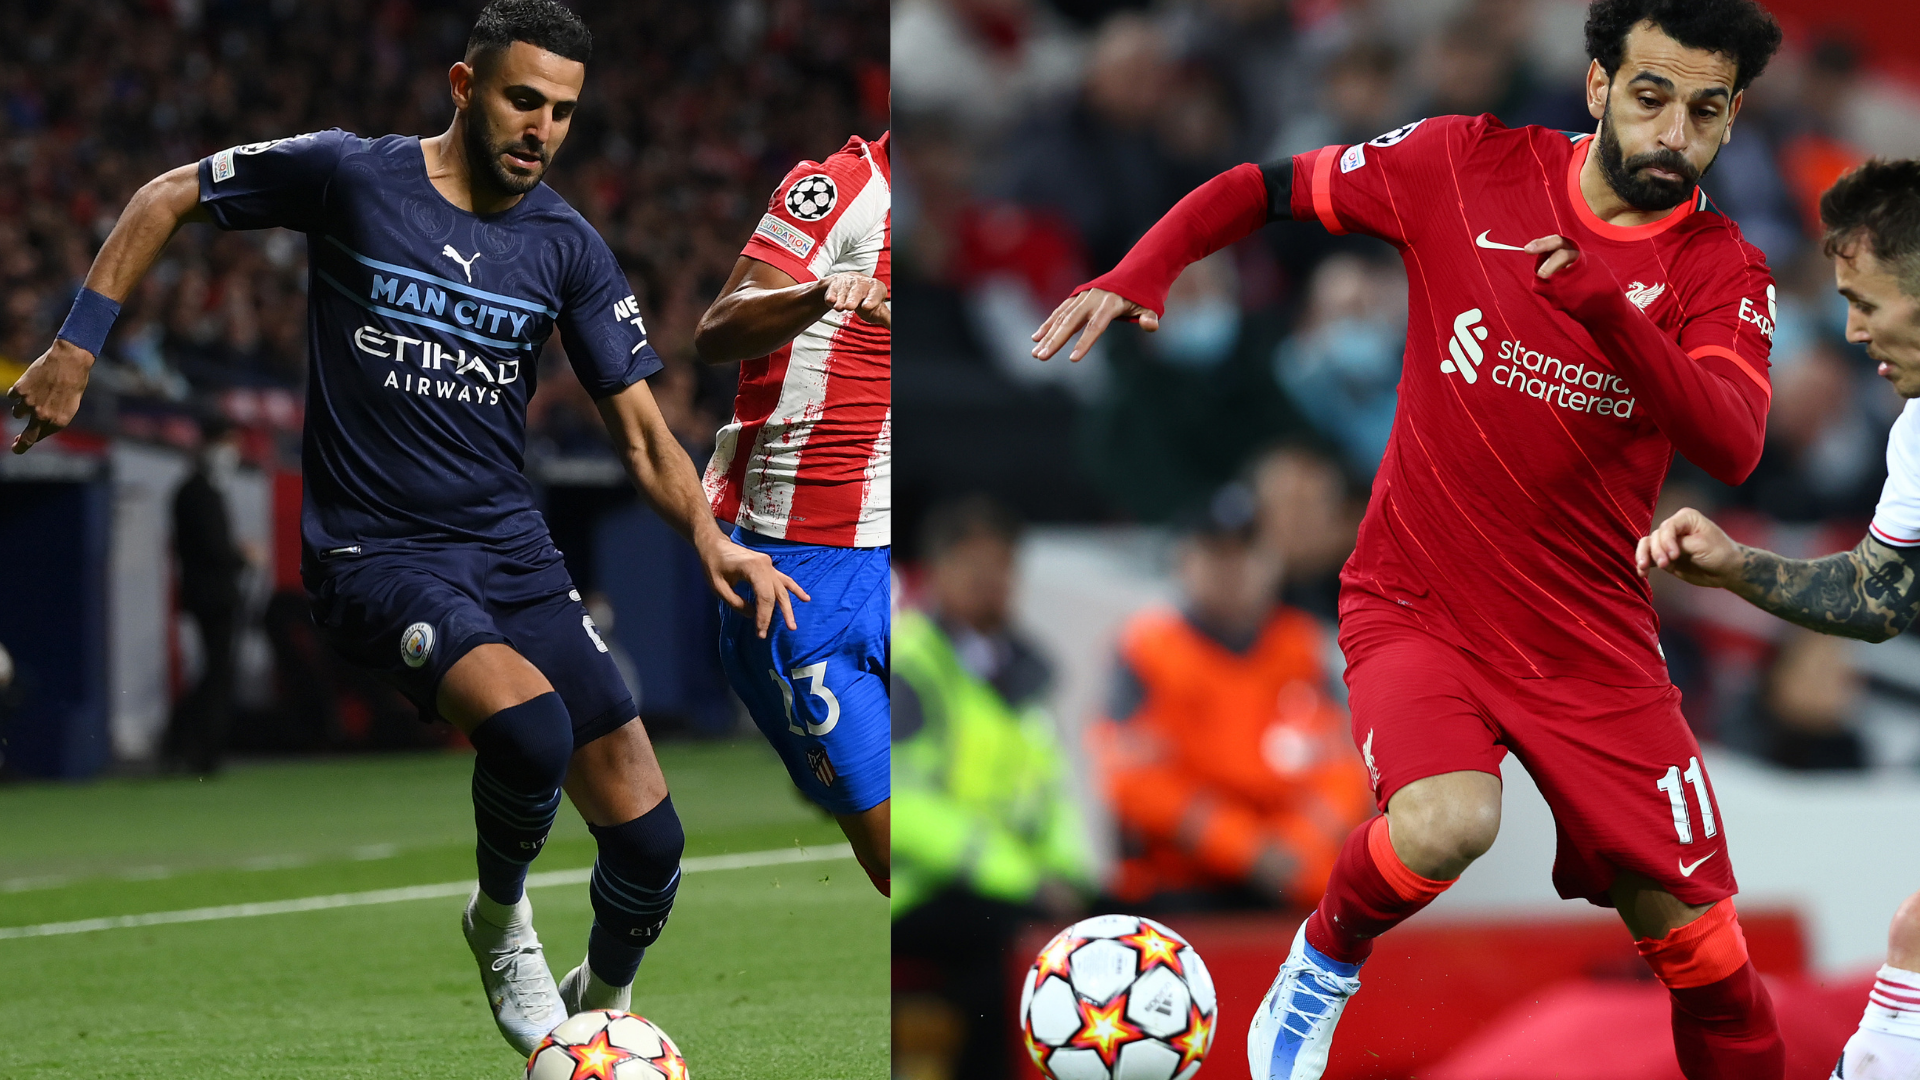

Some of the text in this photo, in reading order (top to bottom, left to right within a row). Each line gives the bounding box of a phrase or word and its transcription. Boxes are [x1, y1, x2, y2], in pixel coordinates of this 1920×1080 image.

[370, 274, 531, 338] MAN CITY
[354, 325, 520, 385] ETIHAD
[384, 370, 502, 406] AIRWAYS
[1492, 364, 1635, 419] chartered
[1656, 756, 1717, 844] 11
